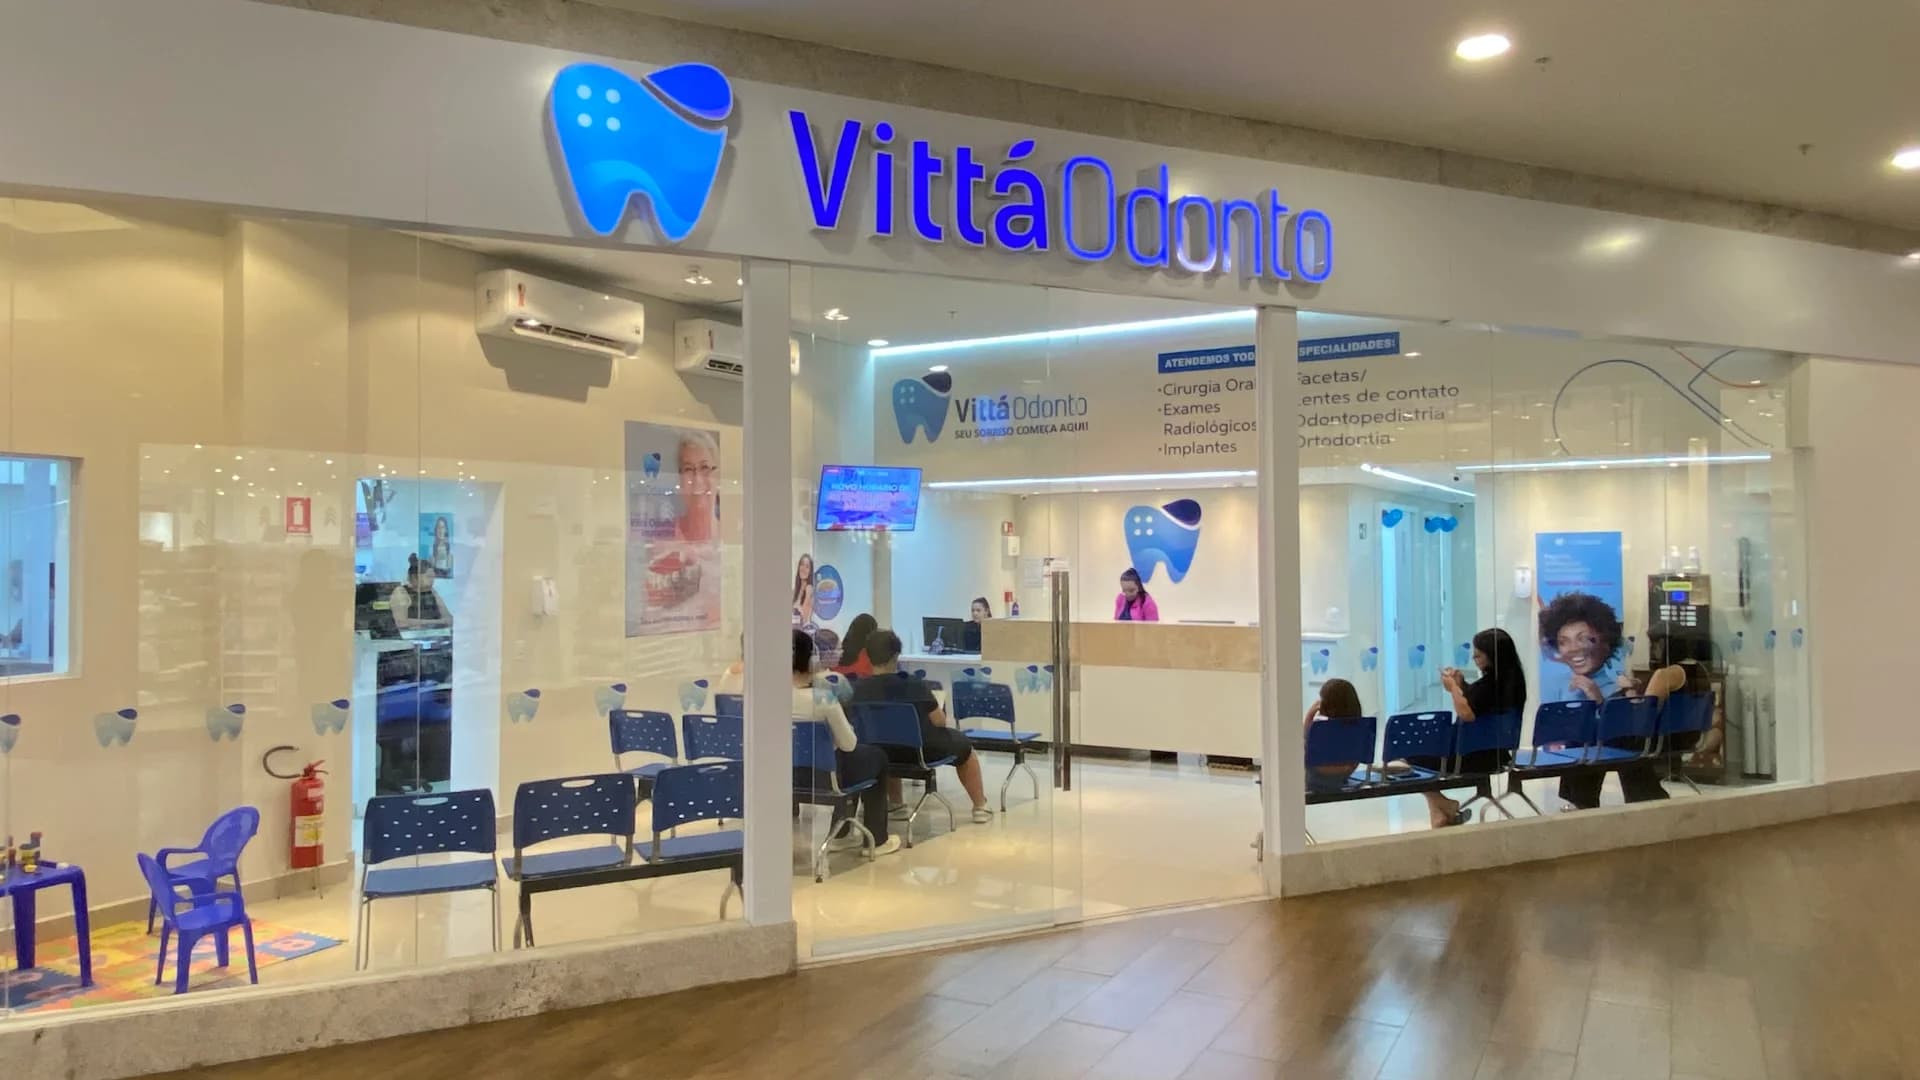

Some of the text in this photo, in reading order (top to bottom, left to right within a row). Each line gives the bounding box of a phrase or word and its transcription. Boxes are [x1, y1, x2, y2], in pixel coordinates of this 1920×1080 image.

[1164, 354, 1230, 368] ATENDEMOS
[1163, 380, 1221, 397] Cirurgia
[1298, 384, 1459, 407] entes de contato
[1163, 403, 1221, 416] Exames
[955, 429, 972, 439] SEU
[1016, 423, 1057, 436] COMEÇA
[1163, 420, 1256, 437] Radiológicos
[1164, 441, 1237, 458] Implantes
